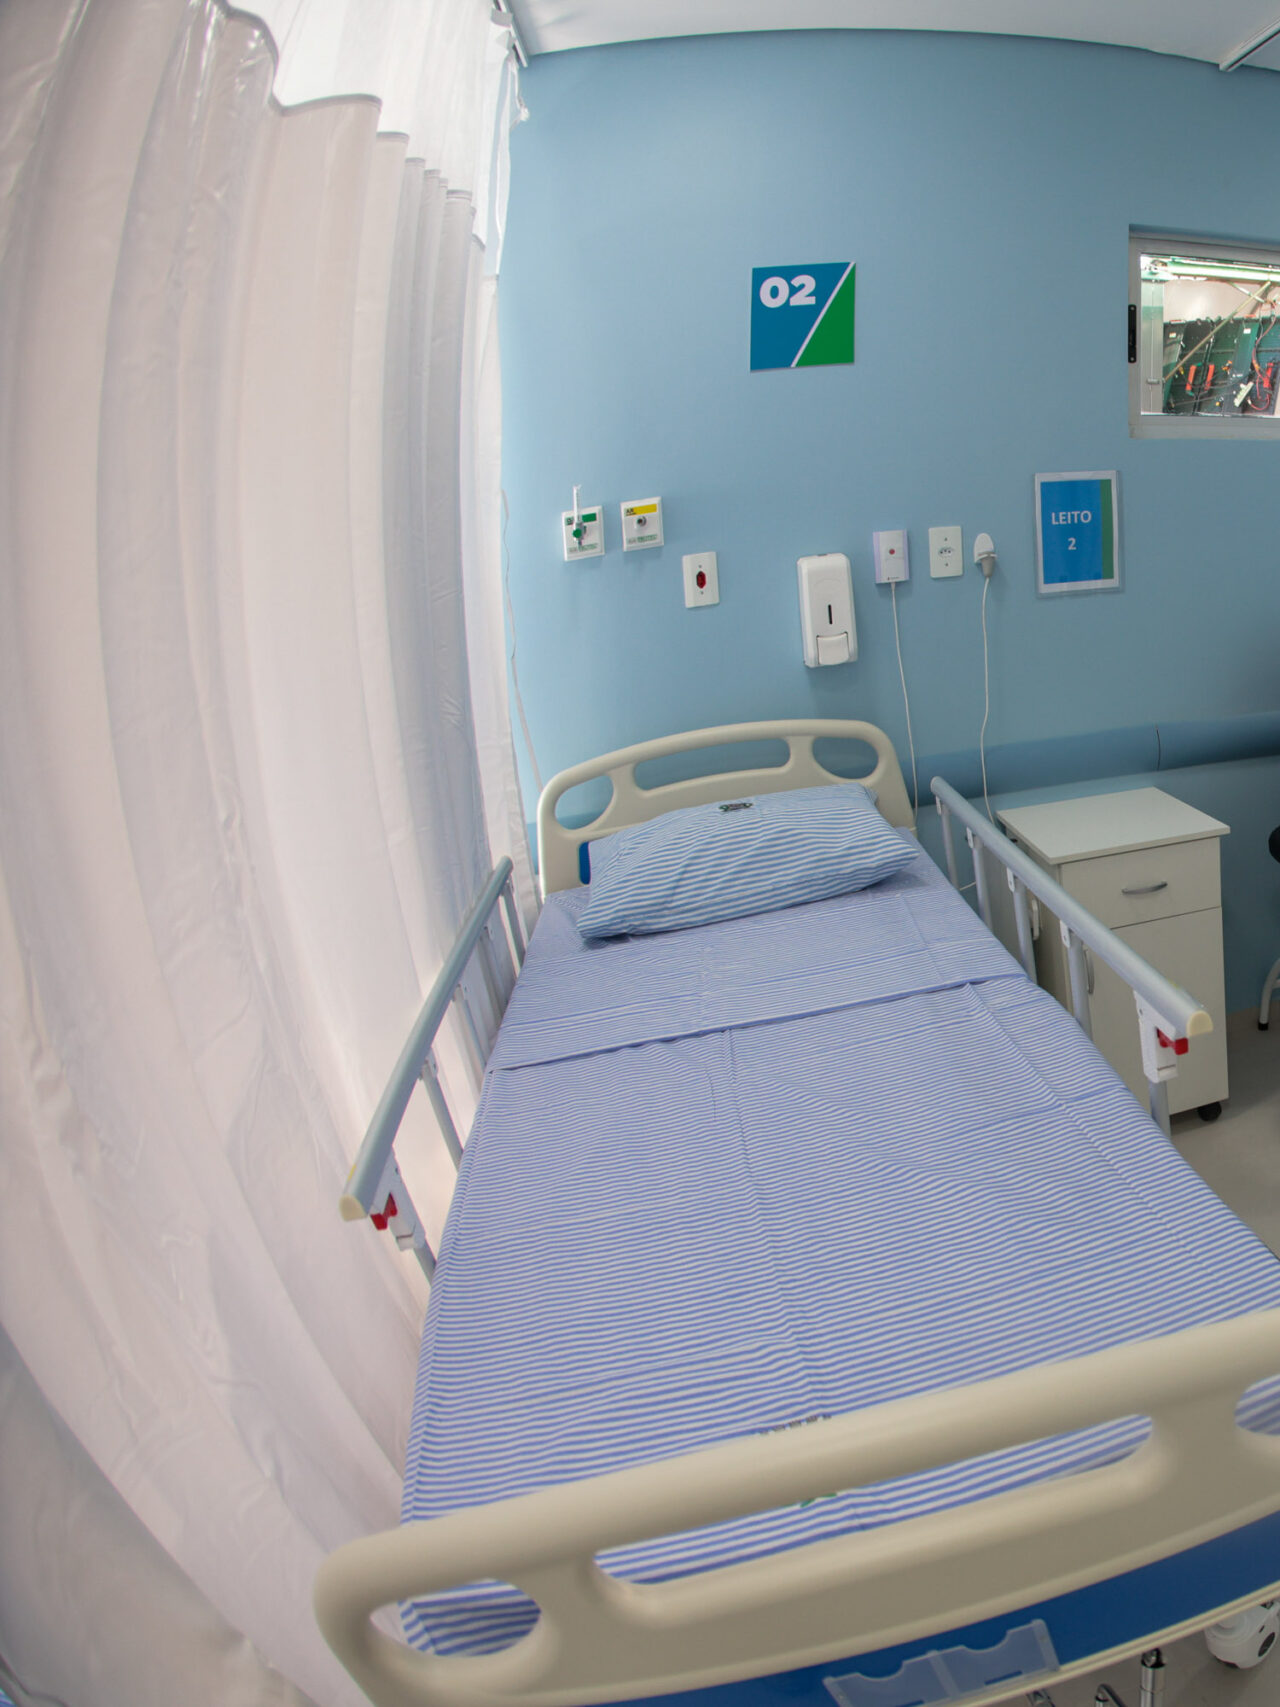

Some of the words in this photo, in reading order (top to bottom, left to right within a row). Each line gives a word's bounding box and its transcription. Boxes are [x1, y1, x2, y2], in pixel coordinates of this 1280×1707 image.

[759, 274, 816, 308] 02
[1051, 510, 1092, 525] LEITO
[1067, 537, 1077, 550] 2
